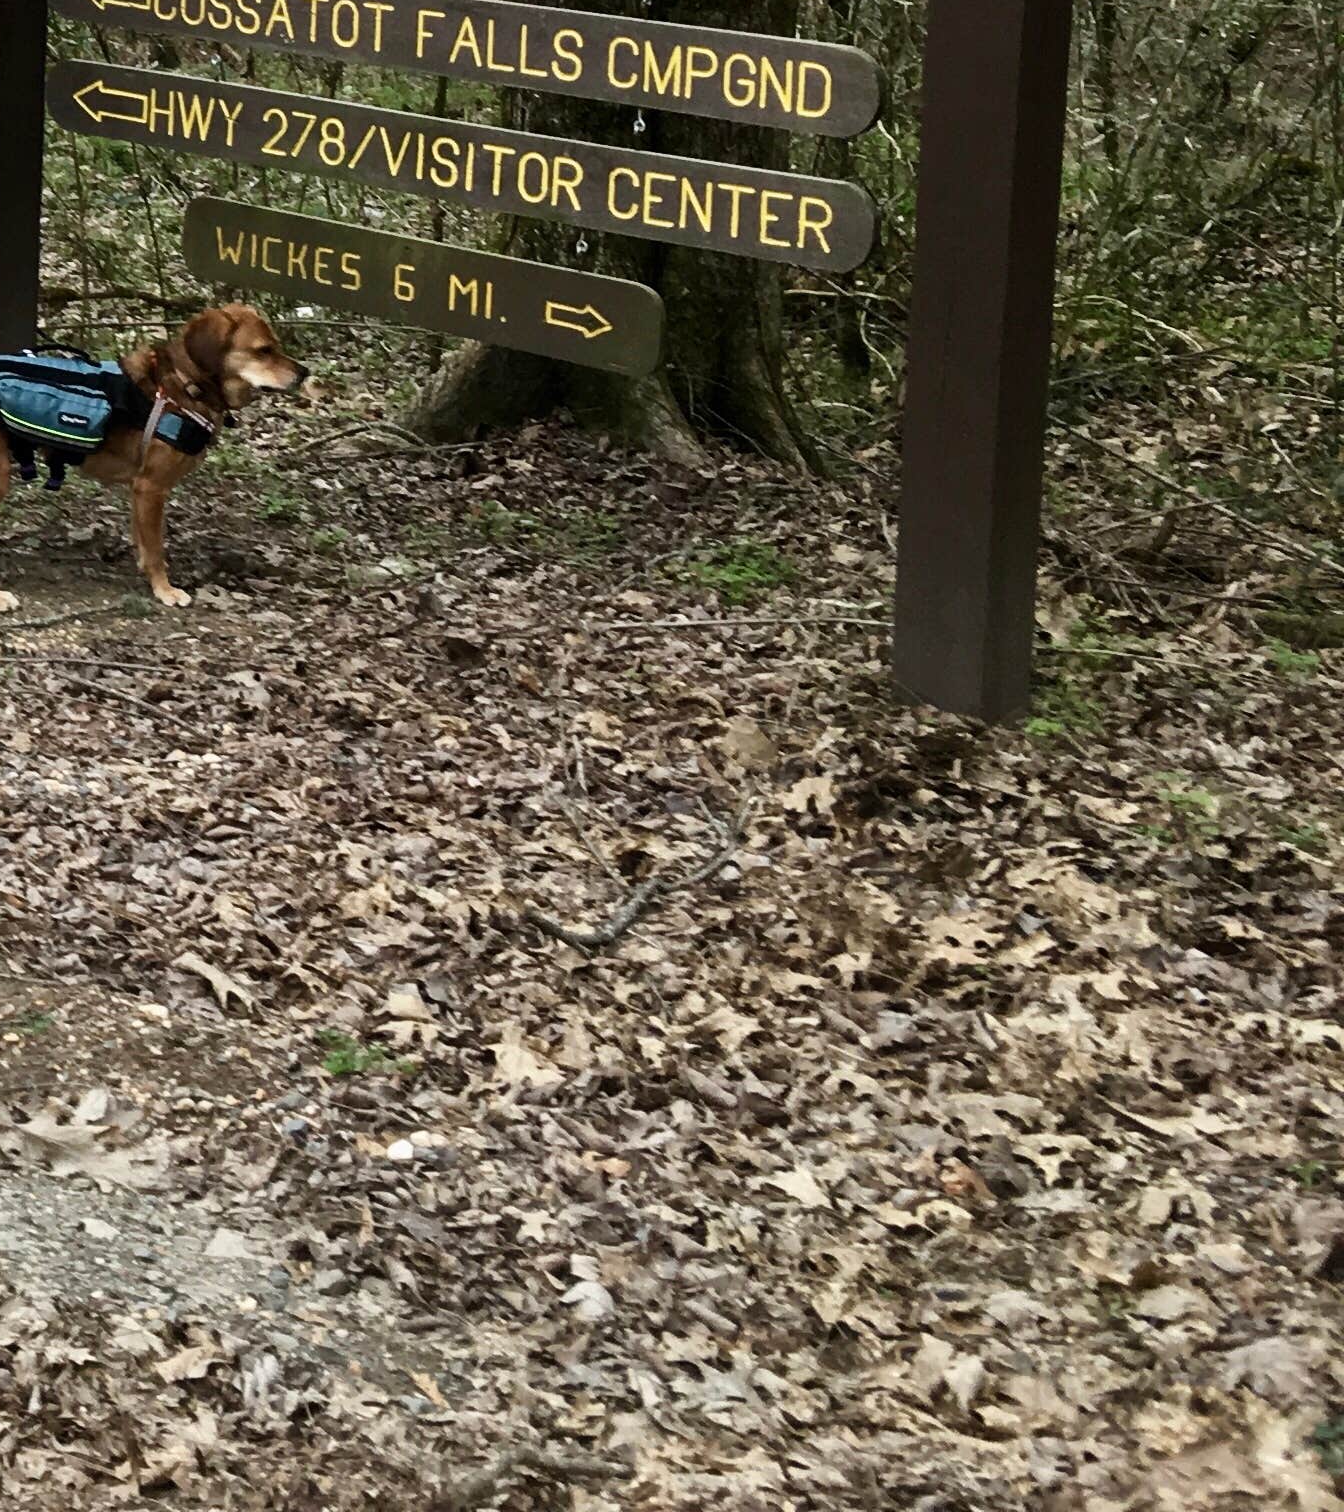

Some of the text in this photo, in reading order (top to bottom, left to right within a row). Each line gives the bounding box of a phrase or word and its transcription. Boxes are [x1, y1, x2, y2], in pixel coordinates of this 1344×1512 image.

[415, 8, 585, 81] FALLS
[604, 35, 832, 118] CMPGND
[149, 88, 833, 254] HWY 278/VISITOR CENTER
[216, 227, 508, 322] WICKES 6 MI.
